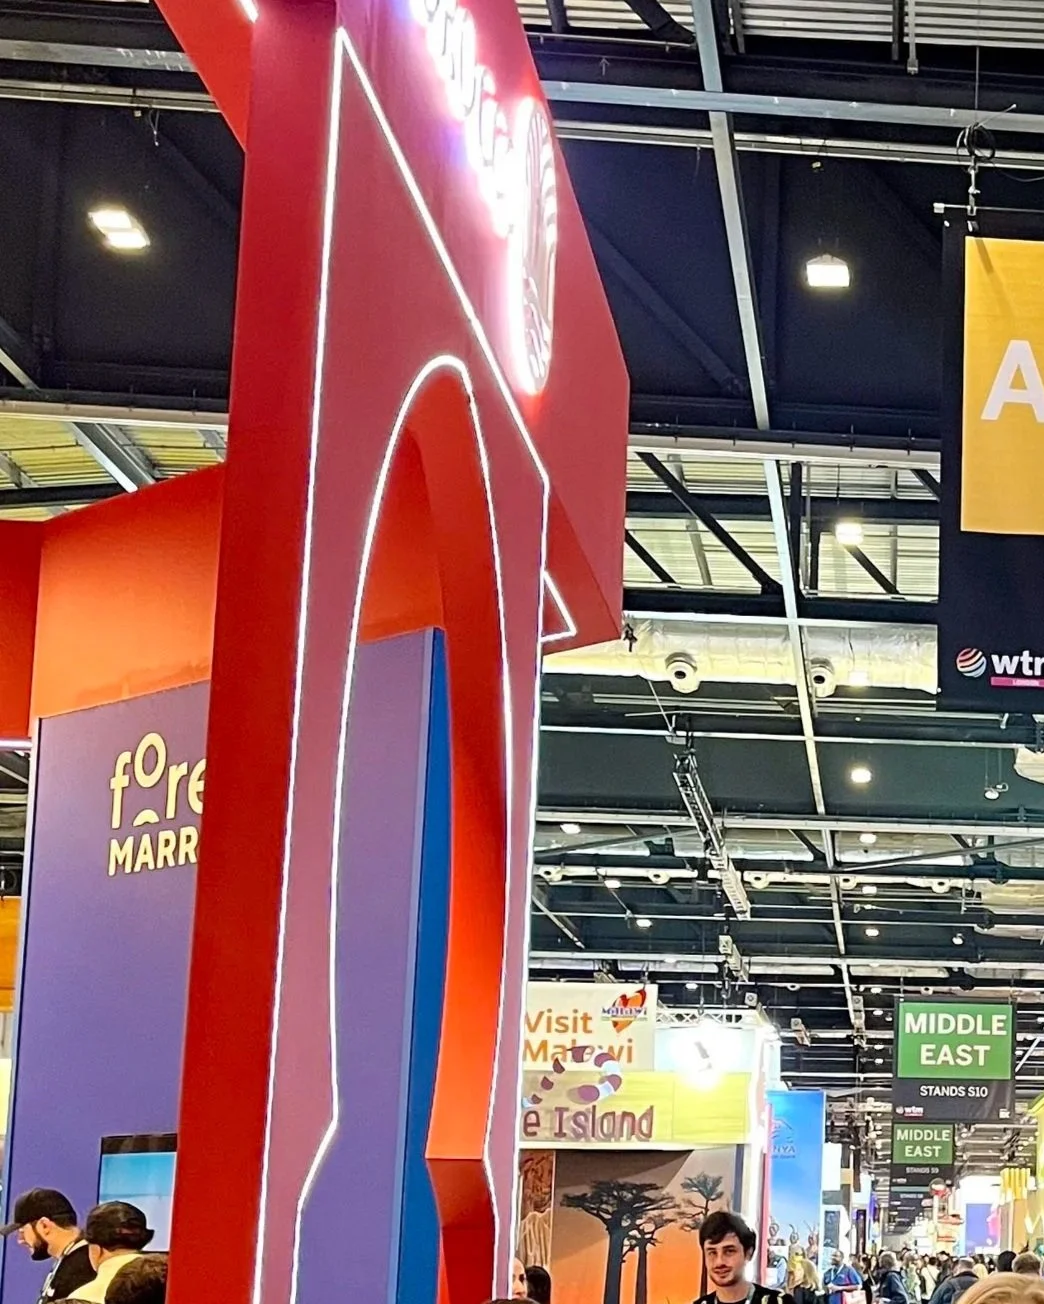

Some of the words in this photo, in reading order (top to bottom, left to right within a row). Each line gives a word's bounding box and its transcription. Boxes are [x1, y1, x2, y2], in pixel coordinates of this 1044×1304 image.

[110, 732, 206, 829] fore
[108, 826, 199, 876] MARR
[525, 1009, 593, 1033] Visit
[904, 1012, 1008, 1036] MIDDLE
[920, 1044, 991, 1067] EAST
[920, 1085, 966, 1097] STANDS
[968, 1086, 988, 1098] S10
[554, 1105, 654, 1142] Island
[896, 1129, 951, 1141] MIDDLE
[905, 1146, 942, 1158] EAST
